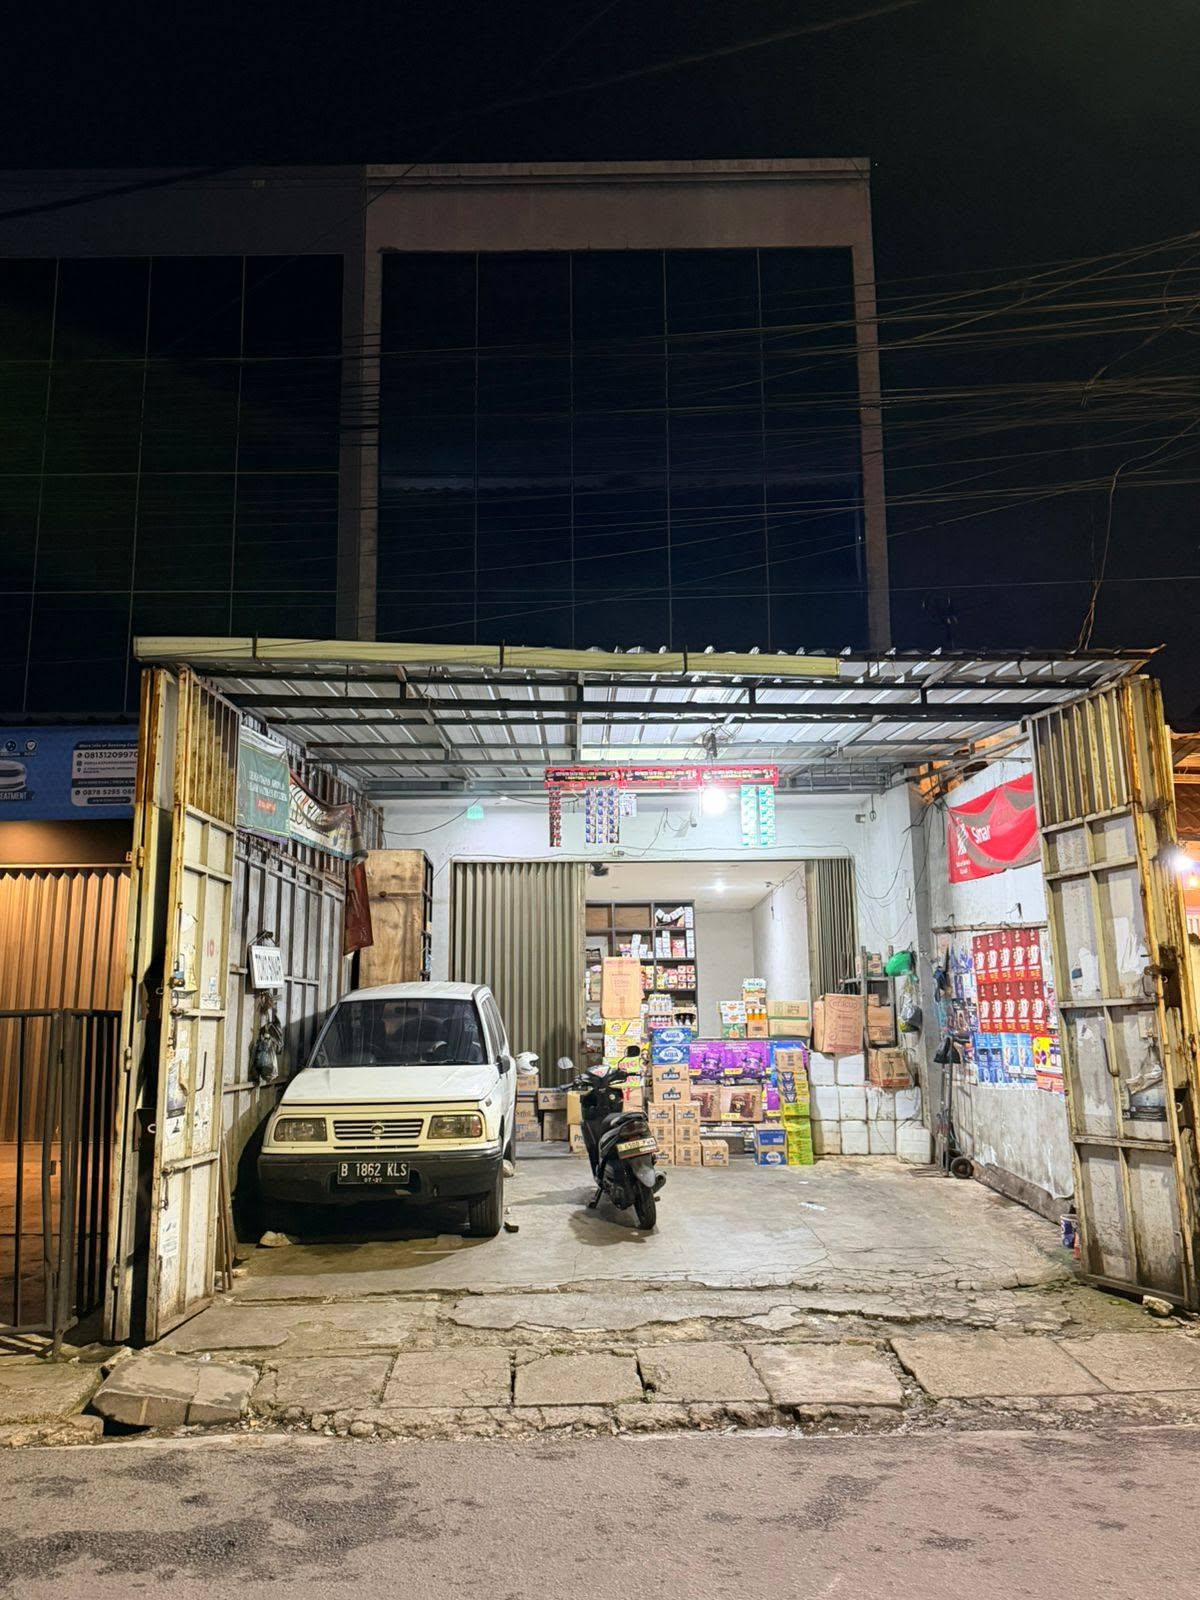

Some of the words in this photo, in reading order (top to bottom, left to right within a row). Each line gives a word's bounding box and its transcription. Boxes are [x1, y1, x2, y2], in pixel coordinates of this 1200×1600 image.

[341, 1163, 348, 1176] B
[356, 1162, 381, 1176] 1862
[387, 1162, 407, 1176] KLS
